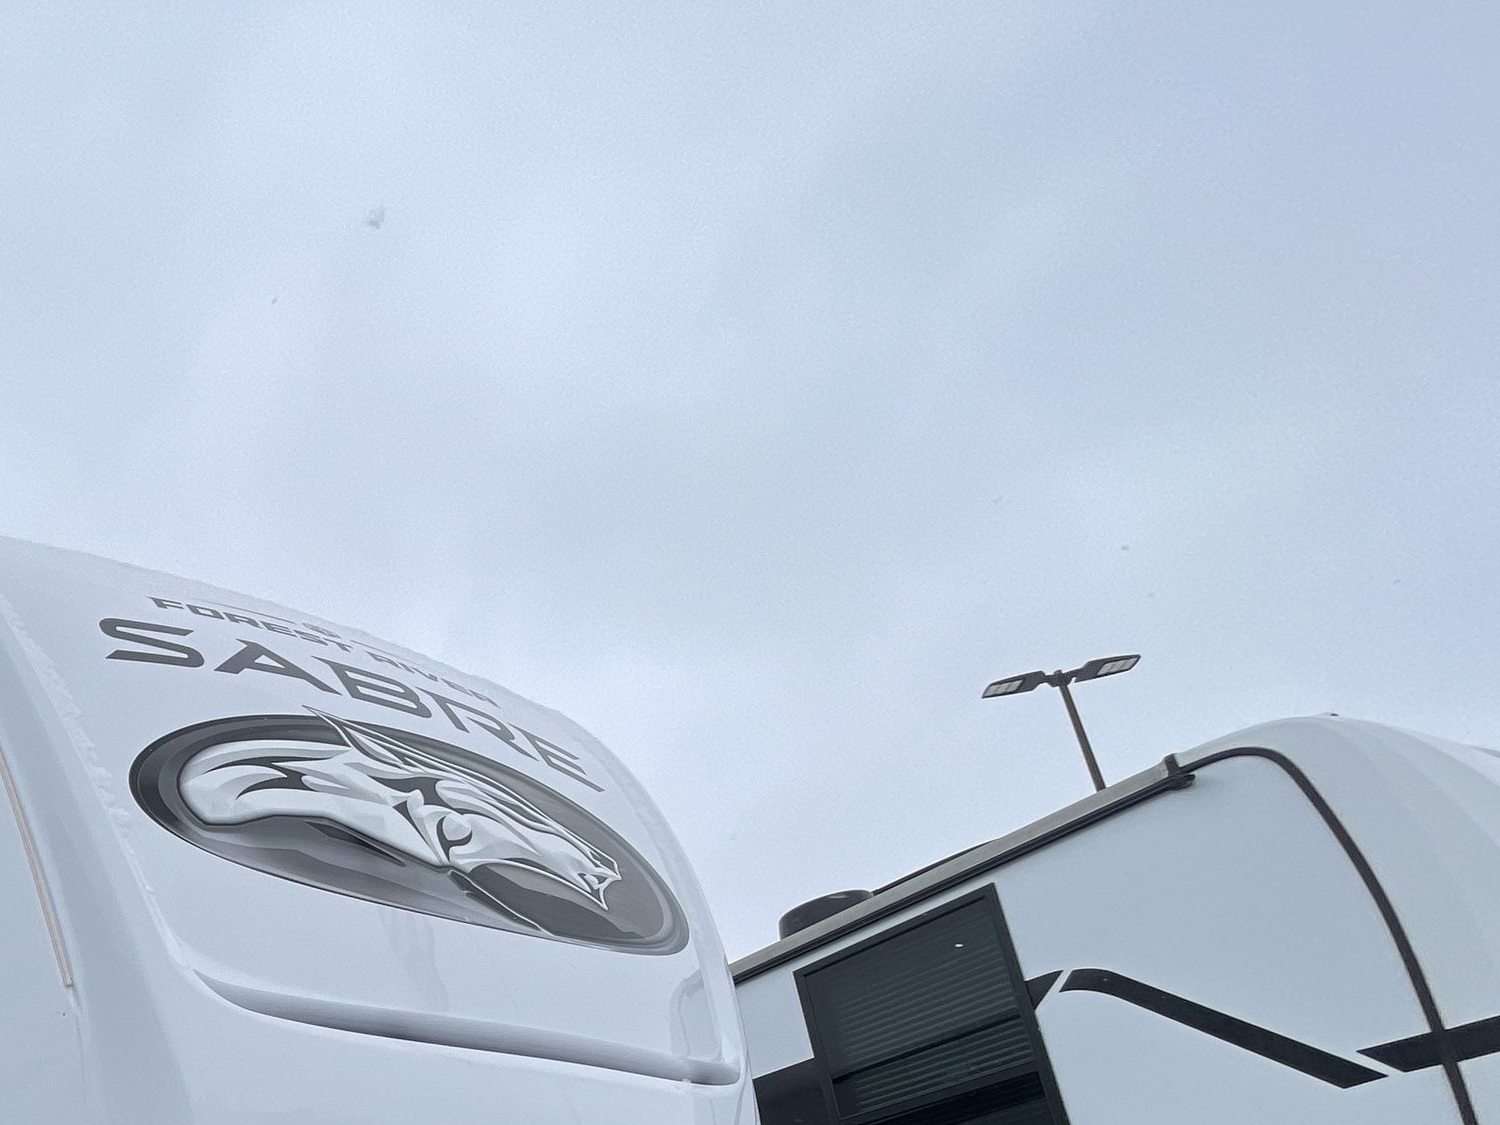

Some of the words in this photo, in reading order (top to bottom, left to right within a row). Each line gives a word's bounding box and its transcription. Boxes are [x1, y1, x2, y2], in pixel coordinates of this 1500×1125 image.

[99, 617, 605, 792] SABRE
[148, 597, 352, 653] FOREST
[363, 650, 500, 709] RIVER
